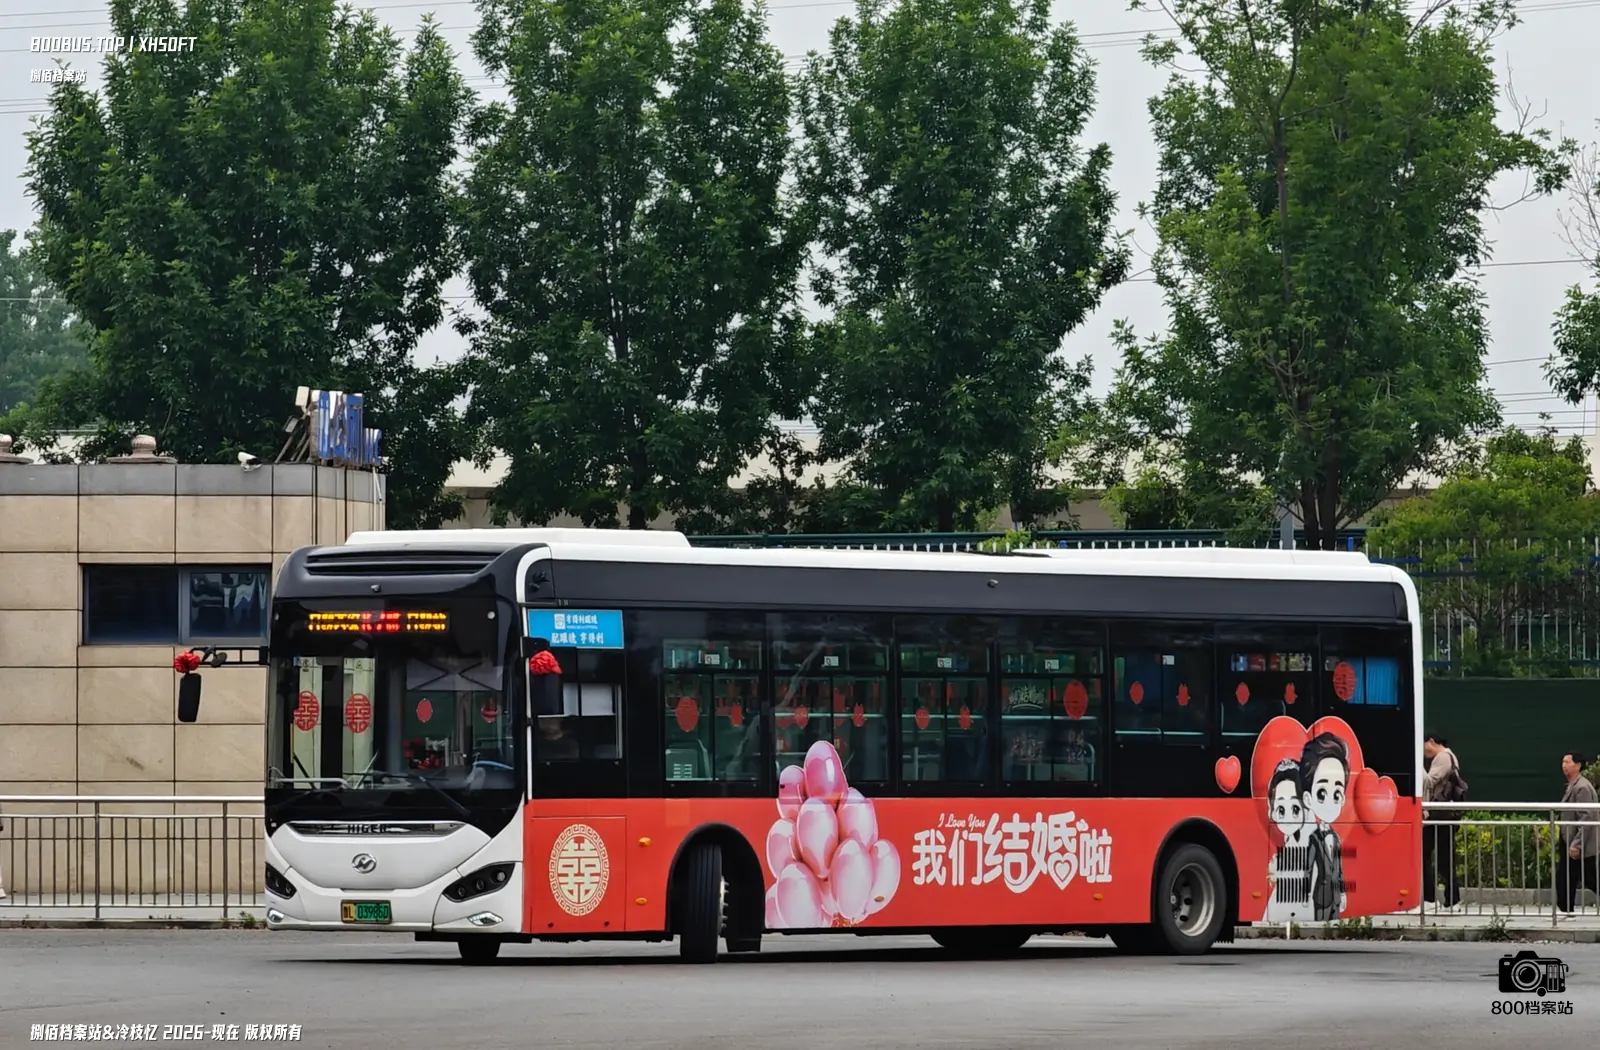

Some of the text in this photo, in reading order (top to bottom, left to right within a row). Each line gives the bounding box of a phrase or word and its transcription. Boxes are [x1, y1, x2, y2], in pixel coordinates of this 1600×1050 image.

[348, 823, 387, 834] HIGER
[945, 813, 966, 828] Love
[968, 813, 986, 832] You
[912, 811, 1113, 894] 我们结婚啦
